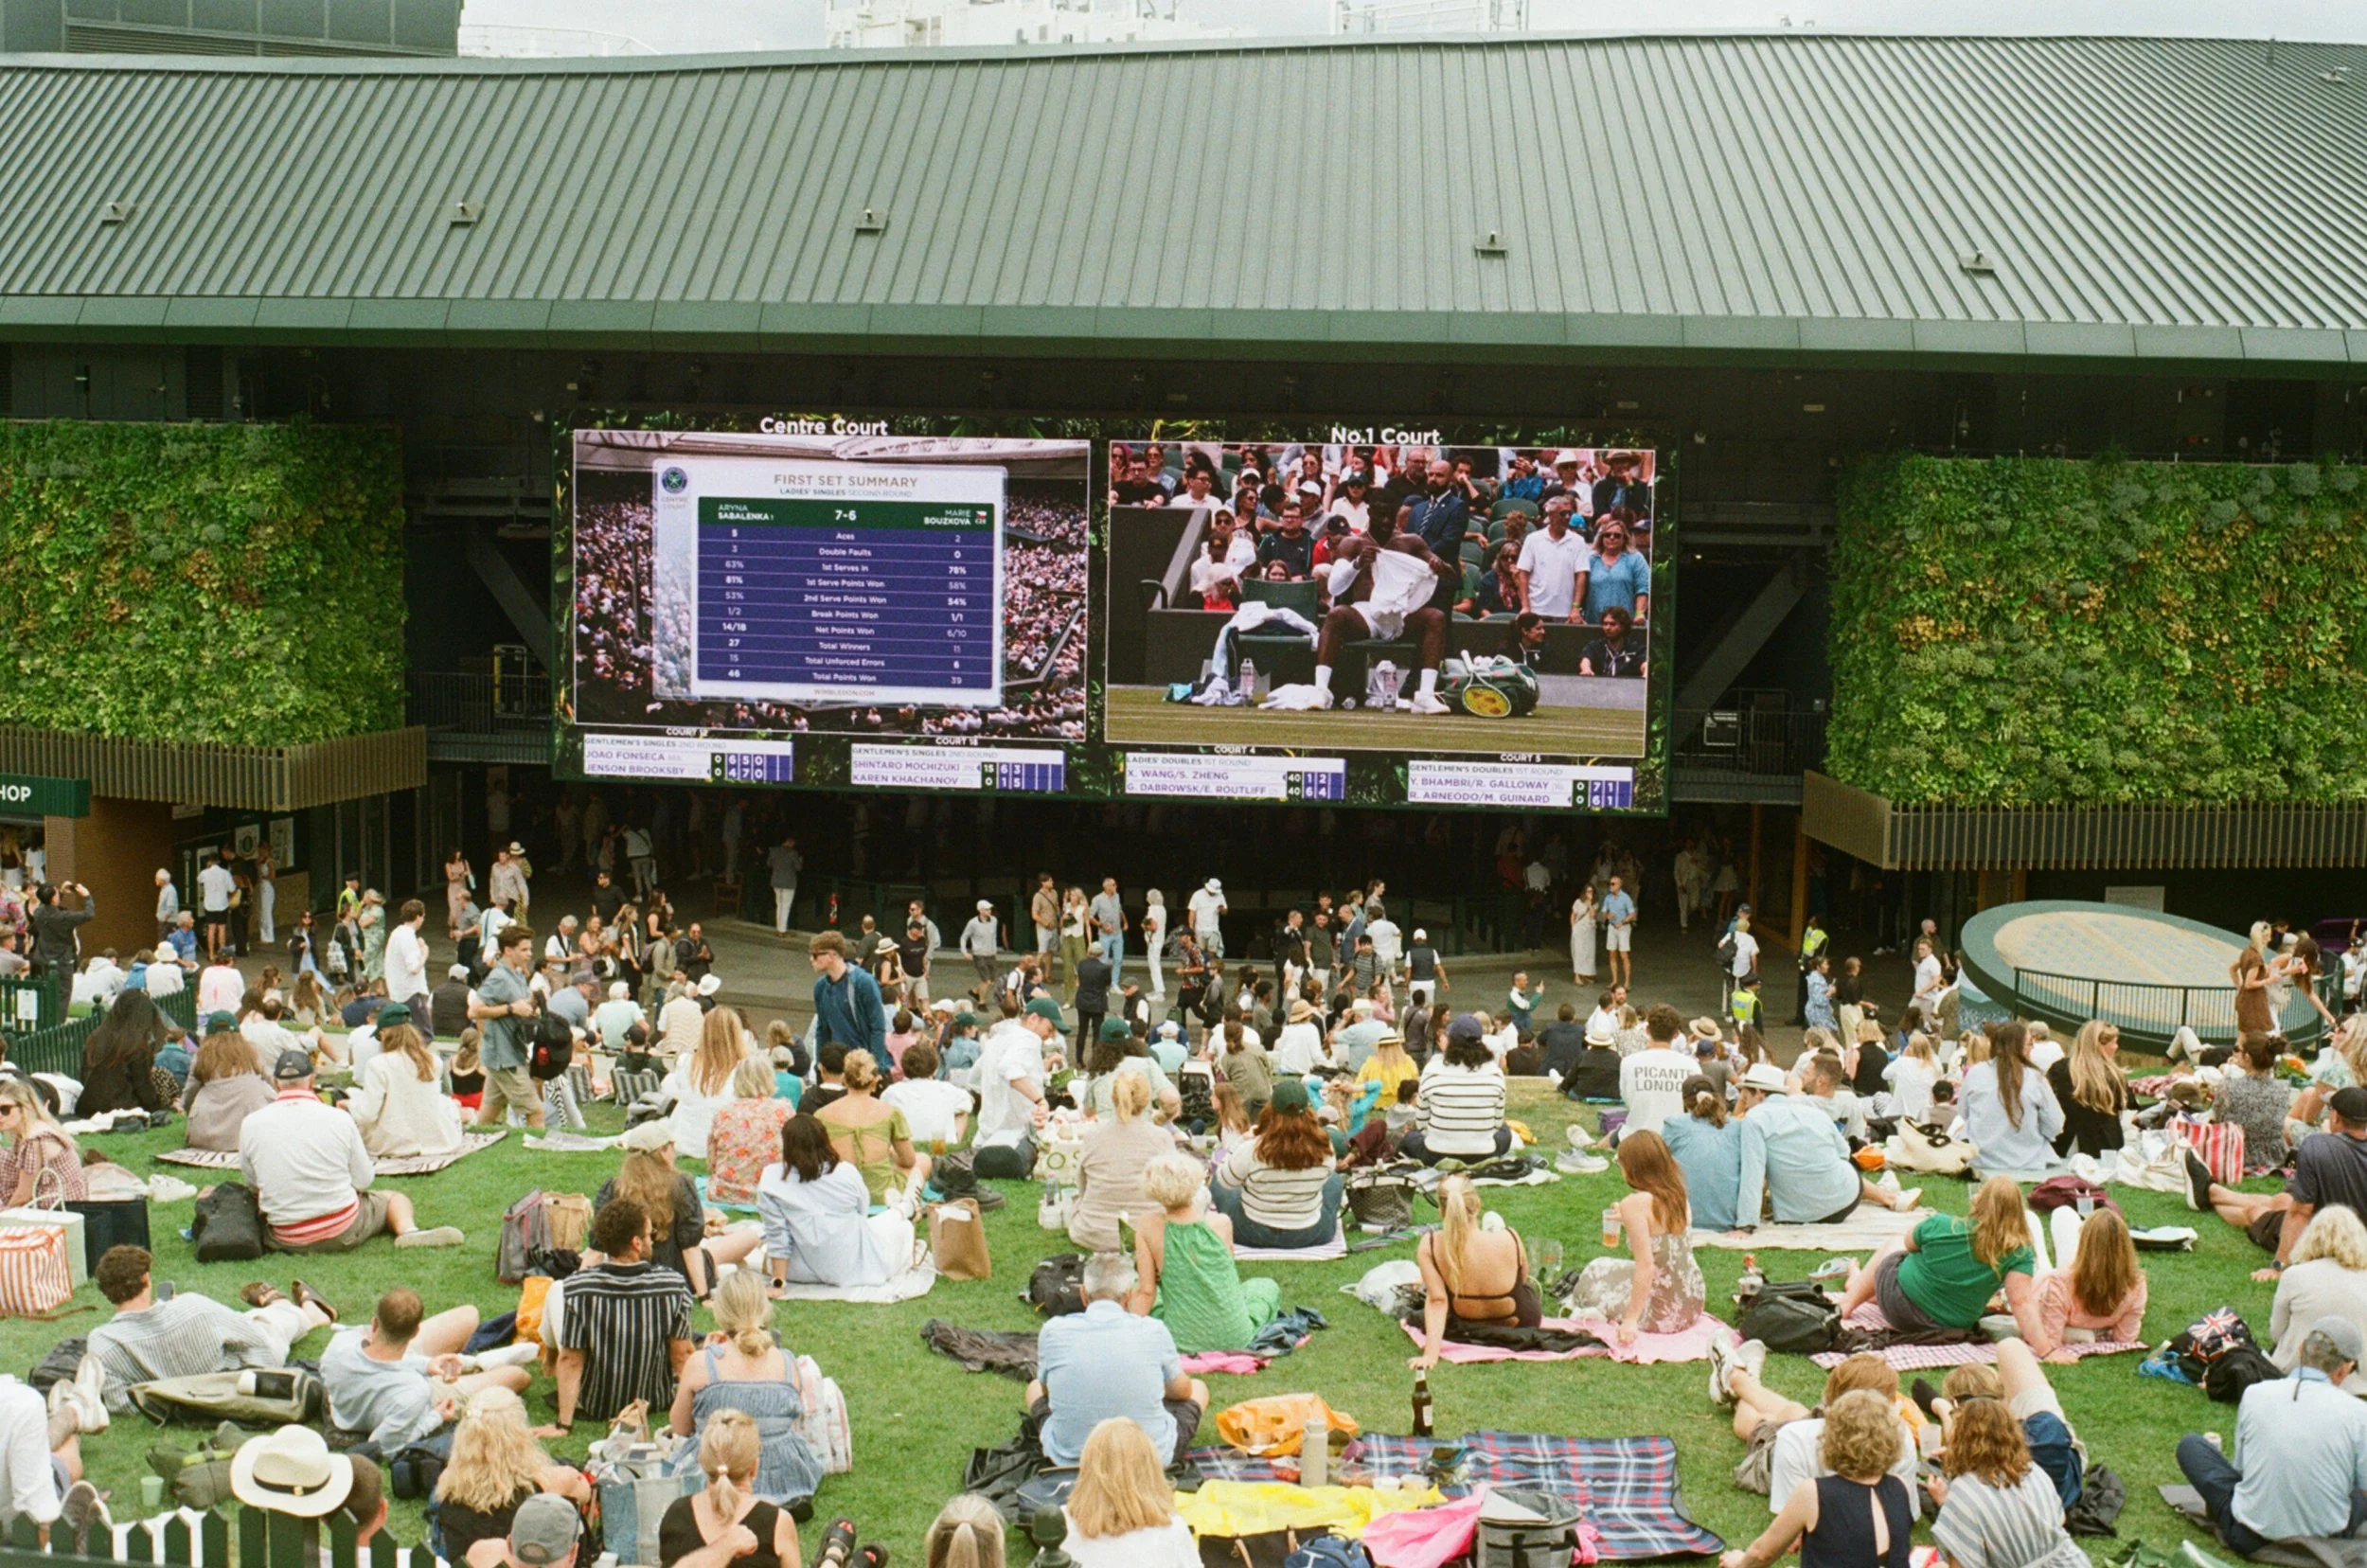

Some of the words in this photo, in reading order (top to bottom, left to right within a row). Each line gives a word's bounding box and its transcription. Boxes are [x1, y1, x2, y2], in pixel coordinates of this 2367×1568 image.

[760, 417, 826, 435] Centre
[832, 418, 888, 436] Court
[1331, 427, 1373, 444] No.1
[1381, 428, 1440, 445] Court
[774, 474, 813, 485] FIRST
[819, 475, 843, 486] SET
[848, 477, 918, 488] SUMMARY
[718, 512, 769, 520] SABALENKA
[835, 510, 856, 521] 7-6
[924, 517, 971, 526] BOUZKOVA
[836, 532, 855, 540] Aces
[819, 548, 847, 556] Double
[849, 548, 872, 556] Faults
[953, 550, 961, 559] 0
[834, 564, 858, 572] Serves
[841, 579, 865, 588] Points
[866, 580, 885, 588] Won
[843, 596, 867, 604] Points
[836, 611, 859, 619] Points
[861, 611, 879, 619] Won
[815, 626, 829, 634] Net
[831, 626, 855, 634] Points
[947, 629, 967, 638] 6/10
[728, 638, 740, 647] 27
[839, 642, 871, 651] Winners
[825, 657, 860, 666] Unforced
[862, 658, 885, 667] Errors
[728, 669, 741, 678] 46
[812, 673, 832, 681] Total
[833, 673, 857, 681] Points
[859, 674, 877, 682] Won
[951, 677, 962, 685] 39
[666, 728, 697, 737] COURT
[586, 738, 641, 747] GENTLEMEN'S
[642, 739, 676, 748] SINGLES
[935, 736, 967, 746] COURT
[852, 748, 910, 757] GENTLEMEN'S
[911, 749, 946, 757] SINGLES
[1214, 746, 1247, 754] COURT
[1249, 747, 1256, 755] 4
[616, 751, 665, 761] FONSECA
[714, 755, 721, 764] 0
[1500, 753, 1533, 762] COURT
[729, 756, 736, 765] 6
[742, 756, 749, 765] 5
[755, 756, 763, 766] 0
[1161, 757, 1202, 766] DOUBLES
[587, 764, 626, 773] JENSON
[629, 765, 685, 775] BROOKSBY
[853, 760, 902, 770] SHINTARO
[904, 762, 960, 772] MOCHIZUKI
[983, 764, 994, 773] 15
[1000, 764, 1008, 774] 6
[1013, 765, 1021, 774] 3
[1409, 764, 1469, 773] GENTLEMEN'S
[1472, 766, 1513, 774] DOUBLES
[714, 767, 721, 776] 0
[728, 769, 736, 778] 4
[742, 769, 750, 778] 7
[755, 769, 763, 779] 0
[1140, 770, 1188, 780] WANG/S.
[1192, 771, 1229, 780] ZHENG
[853, 774, 889, 783] KAREN
[891, 775, 959, 785] KHACHANOV
[985, 777, 993, 786] 0
[1001, 777, 1007, 787] 1
[1014, 778, 1021, 788] 5
[1289, 774, 1301, 783] 40
[1307, 774, 1313, 783] 1
[1319, 774, 1326, 783] 2
[1421, 778, 1486, 789] BHAMBRI/R.
[1489, 780, 1549, 790] GALLOWAY
[1576, 782, 1584, 791] 0
[1593, 783, 1601, 792] 7
[1607, 783, 1613, 792] 1
[1216, 786, 1266, 794] ROUTLIFF
[1289, 787, 1301, 796] 40
[1306, 787, 1313, 796] 6
[1318, 787, 1327, 797] 4
[1423, 793, 1496, 802] ARNEODO/M.
[1499, 794, 1550, 803] GUINARD
[1576, 796, 1584, 804] 0
[1592, 796, 1601, 805] 6
[1607, 796, 1613, 806] 1
[1635, 1079, 1683, 1093] LONDO
